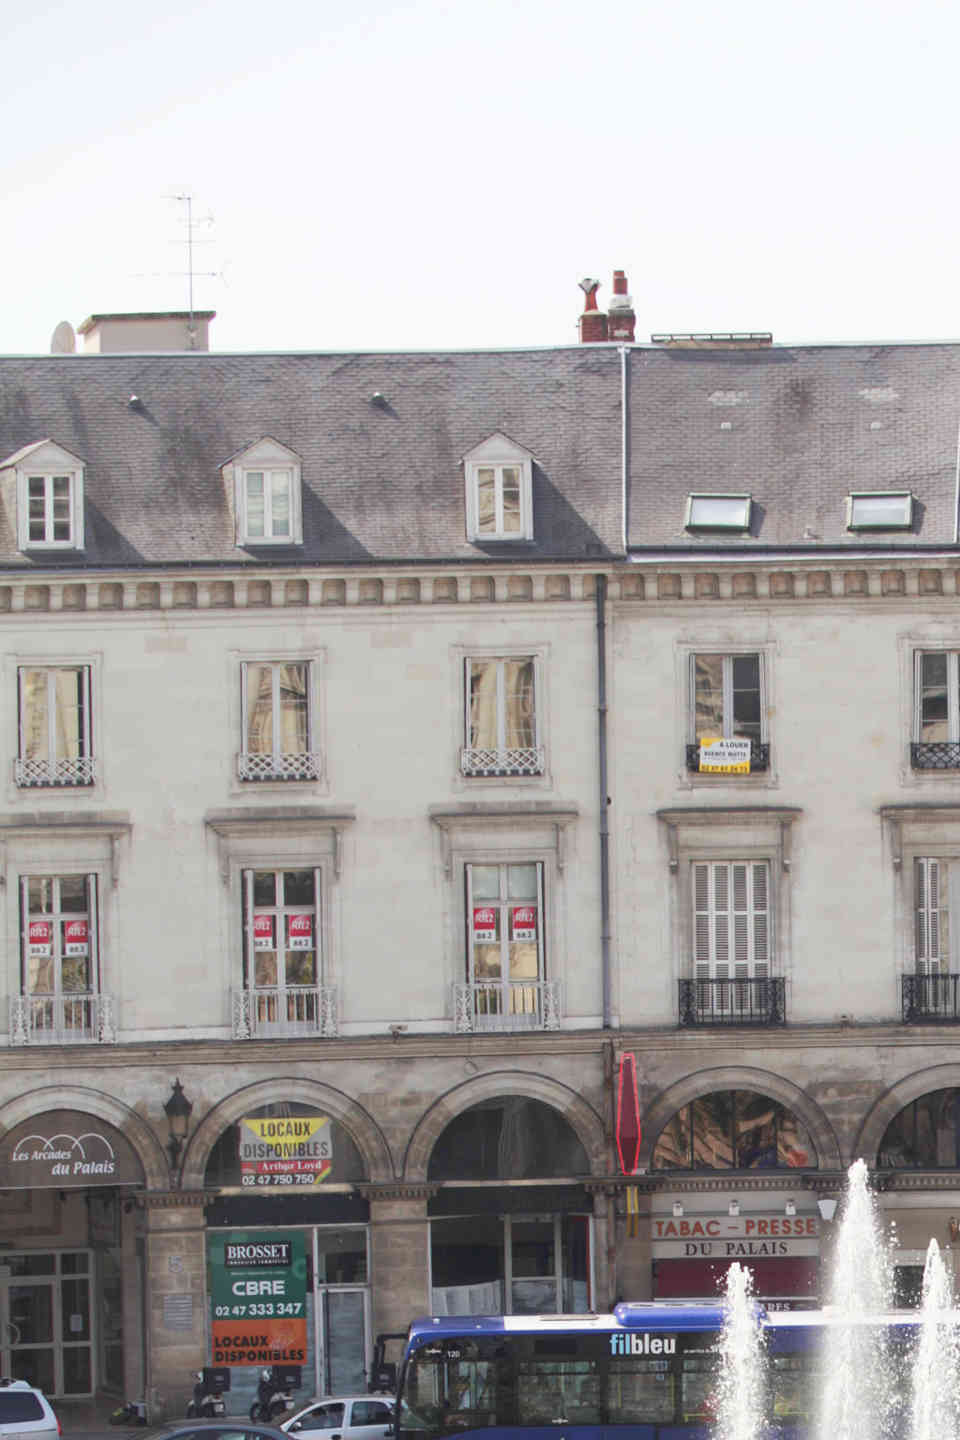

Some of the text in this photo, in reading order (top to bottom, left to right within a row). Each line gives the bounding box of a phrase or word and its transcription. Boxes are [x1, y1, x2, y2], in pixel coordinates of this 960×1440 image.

[260, 1121, 312, 1137] LOCAUX
[12, 1150, 72, 1161] Les Arcades
[243, 1142, 329, 1158] DISPONIBLES
[51, 1160, 115, 1175] du Palais
[241, 1173, 314, 1186] 02 47 750 750
[655, 1220, 721, 1237] TABAC
[745, 1218, 817, 1235] PRESSE
[227, 1244, 289, 1259] BROSSET
[685, 1241, 788, 1257] DU PALAIS
[232, 1280, 286, 1296] CBRE
[215, 1302, 302, 1317] 02 47 333 347
[214, 1335, 269, 1348] LOCAUX
[609, 1333, 676, 1355] filbleu
[215, 1349, 305, 1362] DISPONIBLES
